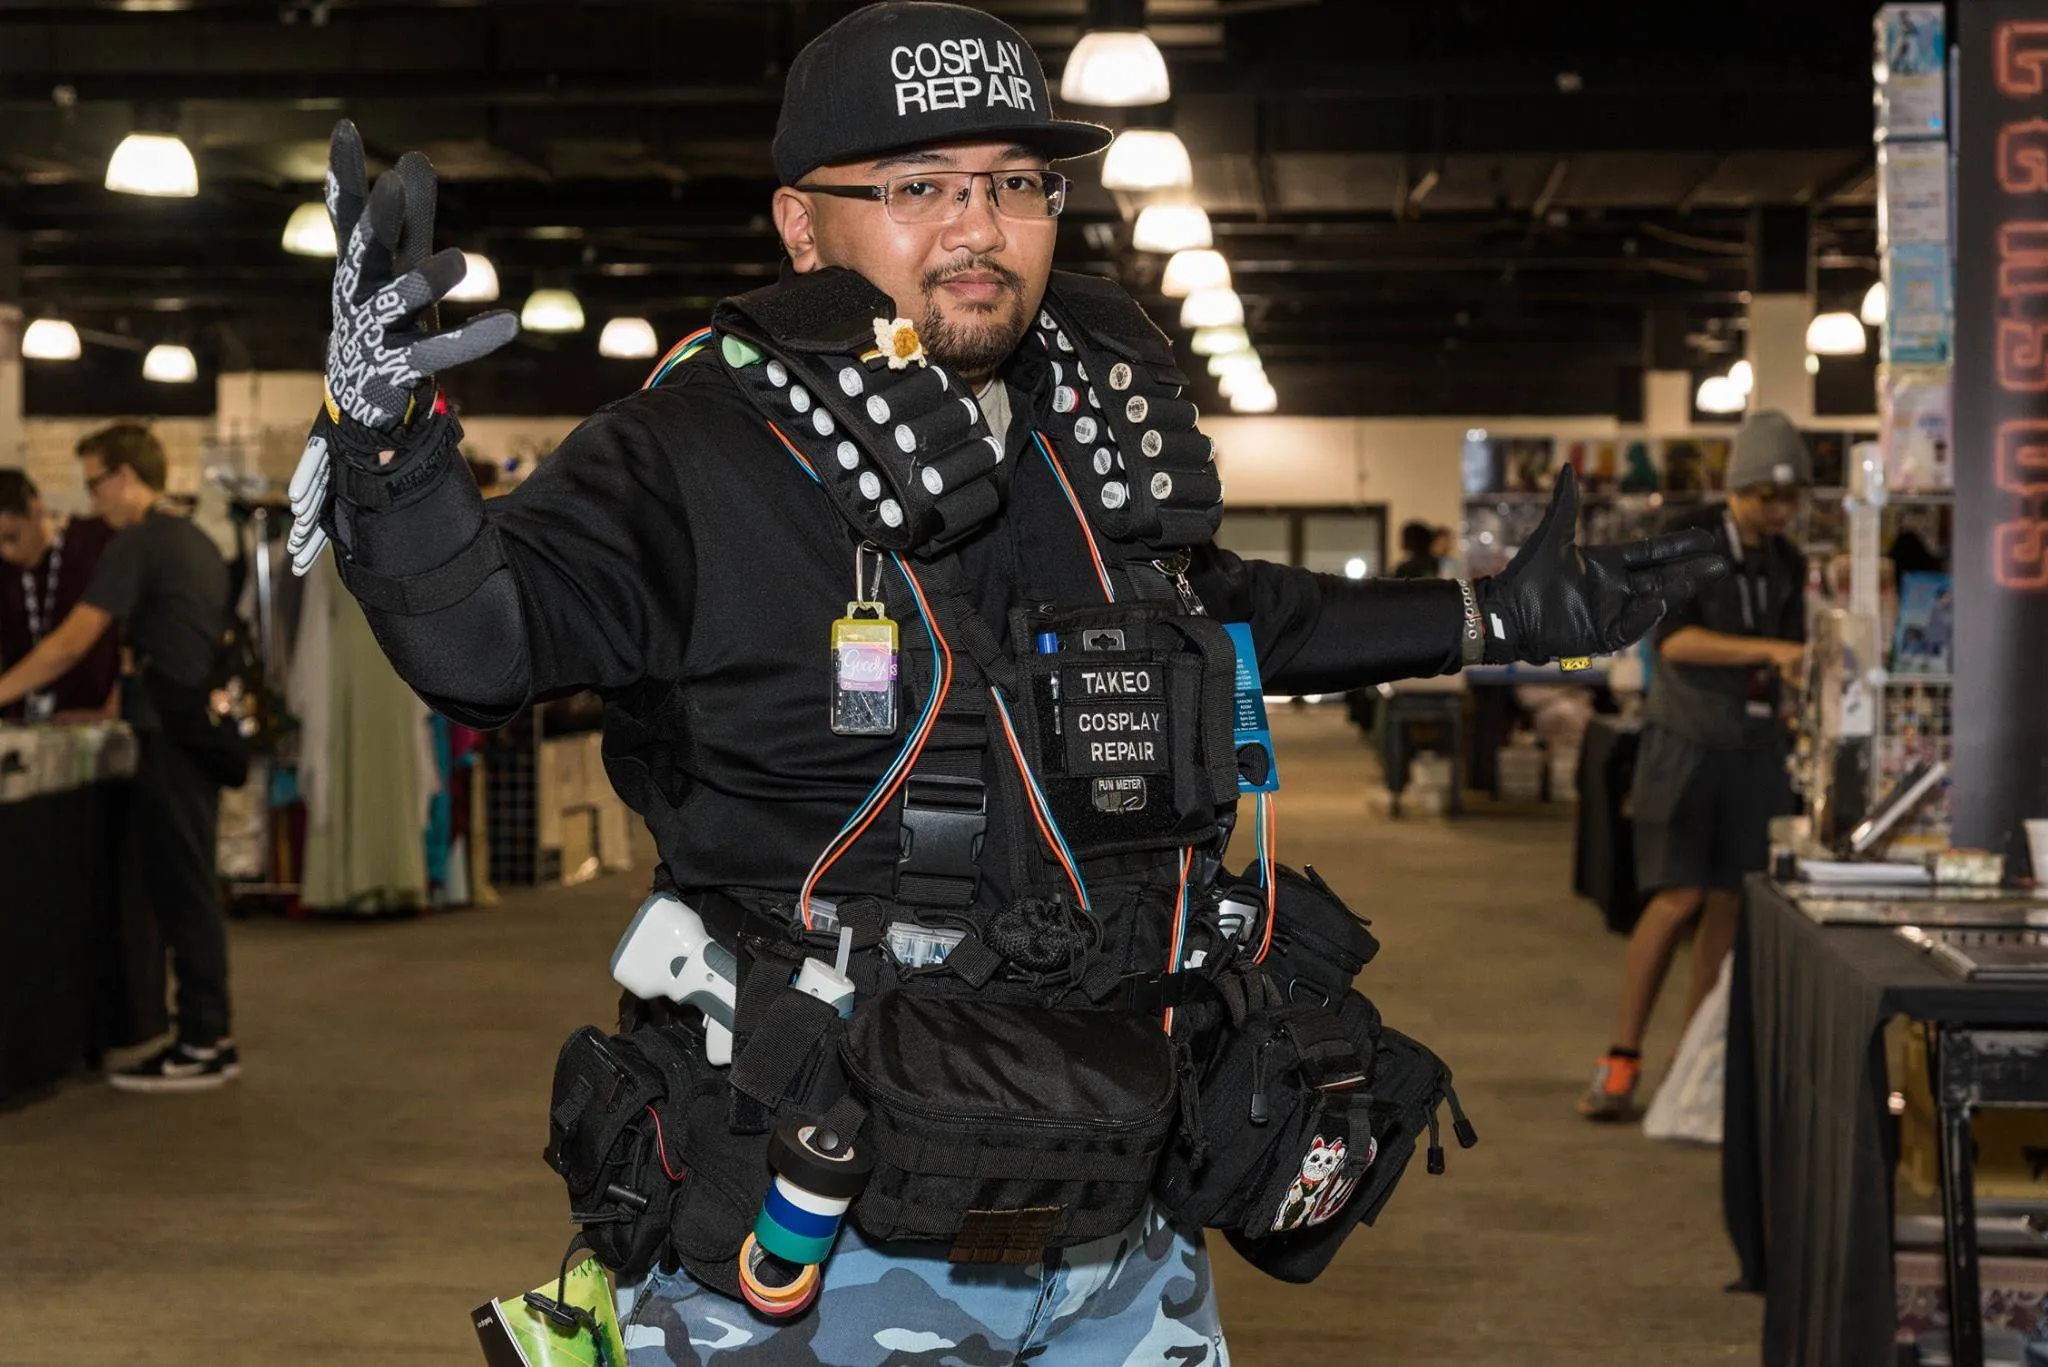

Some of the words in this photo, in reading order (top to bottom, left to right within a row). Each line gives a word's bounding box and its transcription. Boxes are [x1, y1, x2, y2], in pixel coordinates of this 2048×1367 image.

[891, 38, 1023, 81] COSPLAY
[895, 74, 1036, 116] REPAIR
[1082, 671, 1151, 694] TAKEO
[1079, 713, 1160, 732] COSPLAY
[1091, 742, 1156, 762] REPAIR
[1098, 779, 1114, 791] FUN
[1116, 778, 1142, 790] METER
